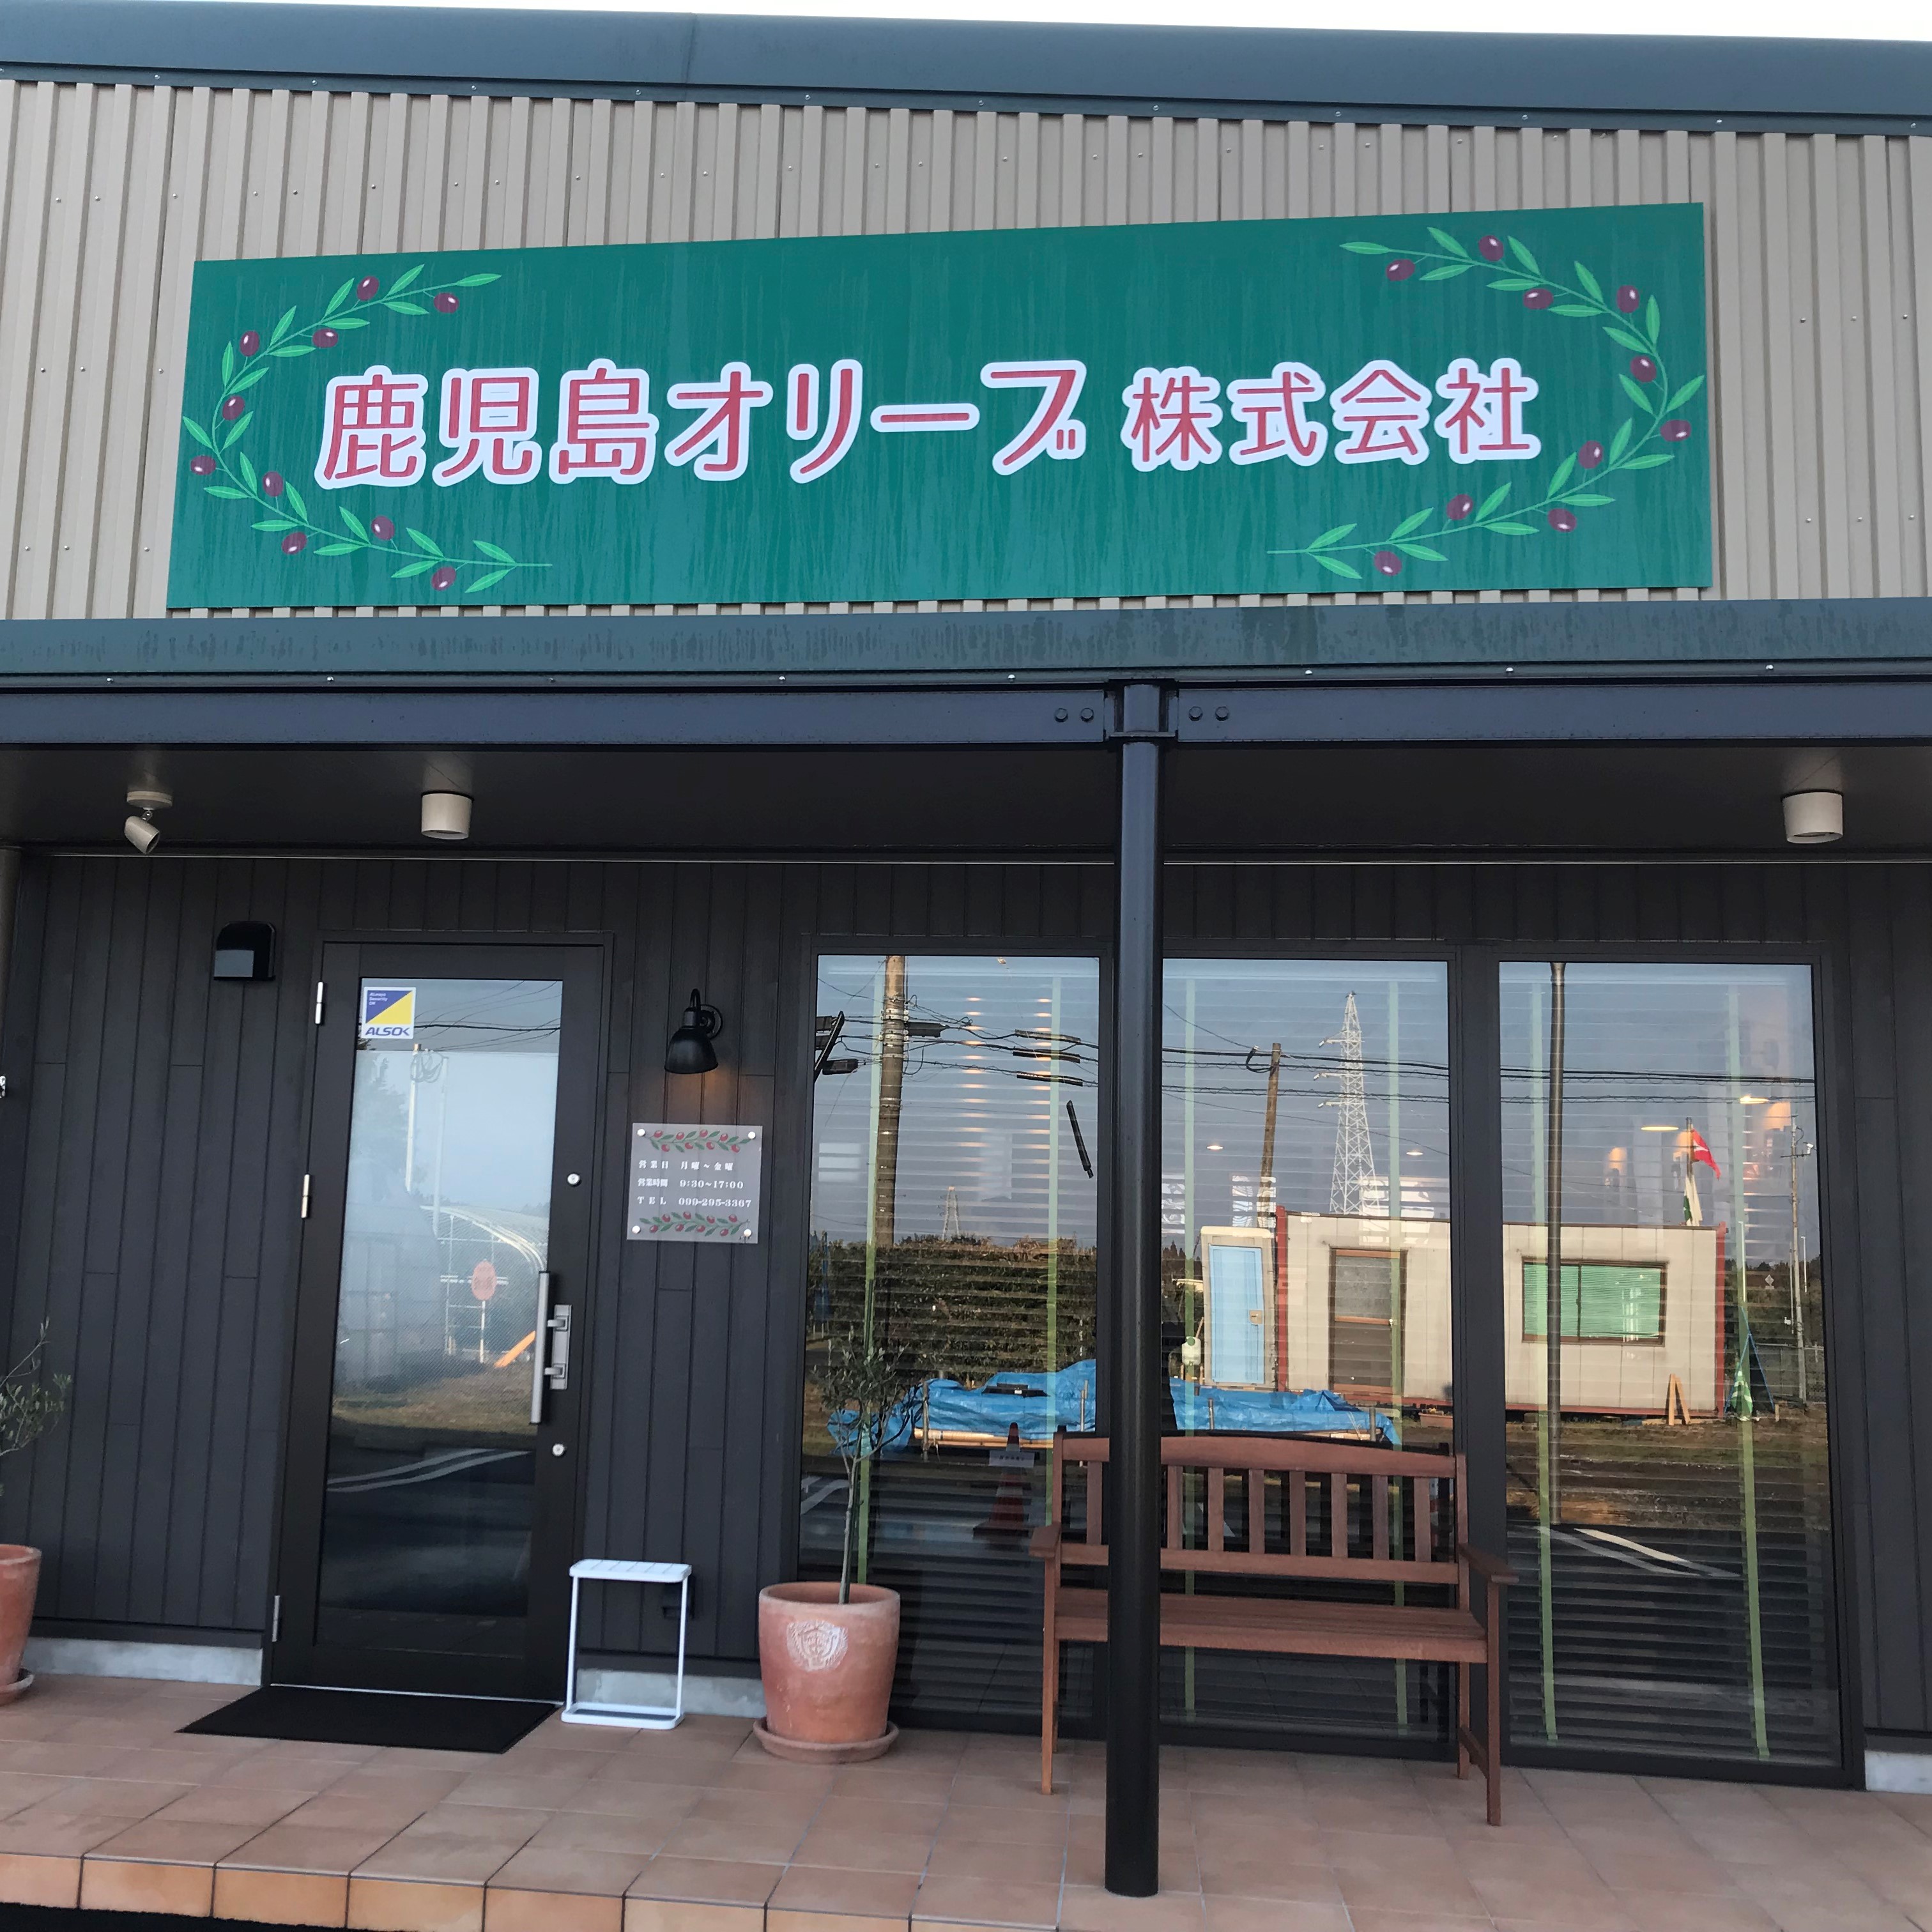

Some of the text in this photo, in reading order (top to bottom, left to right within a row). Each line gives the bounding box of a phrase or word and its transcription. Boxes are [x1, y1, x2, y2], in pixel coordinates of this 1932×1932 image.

[315, 358, 1541, 490] 鹿児島オリーブ 株式会社
[365, 1027, 410, 1036] ALSOK
[638, 1160, 669, 1170] 営業日
[637, 1177, 668, 1188] 営業時間
[637, 1196, 668, 1205] TEL
